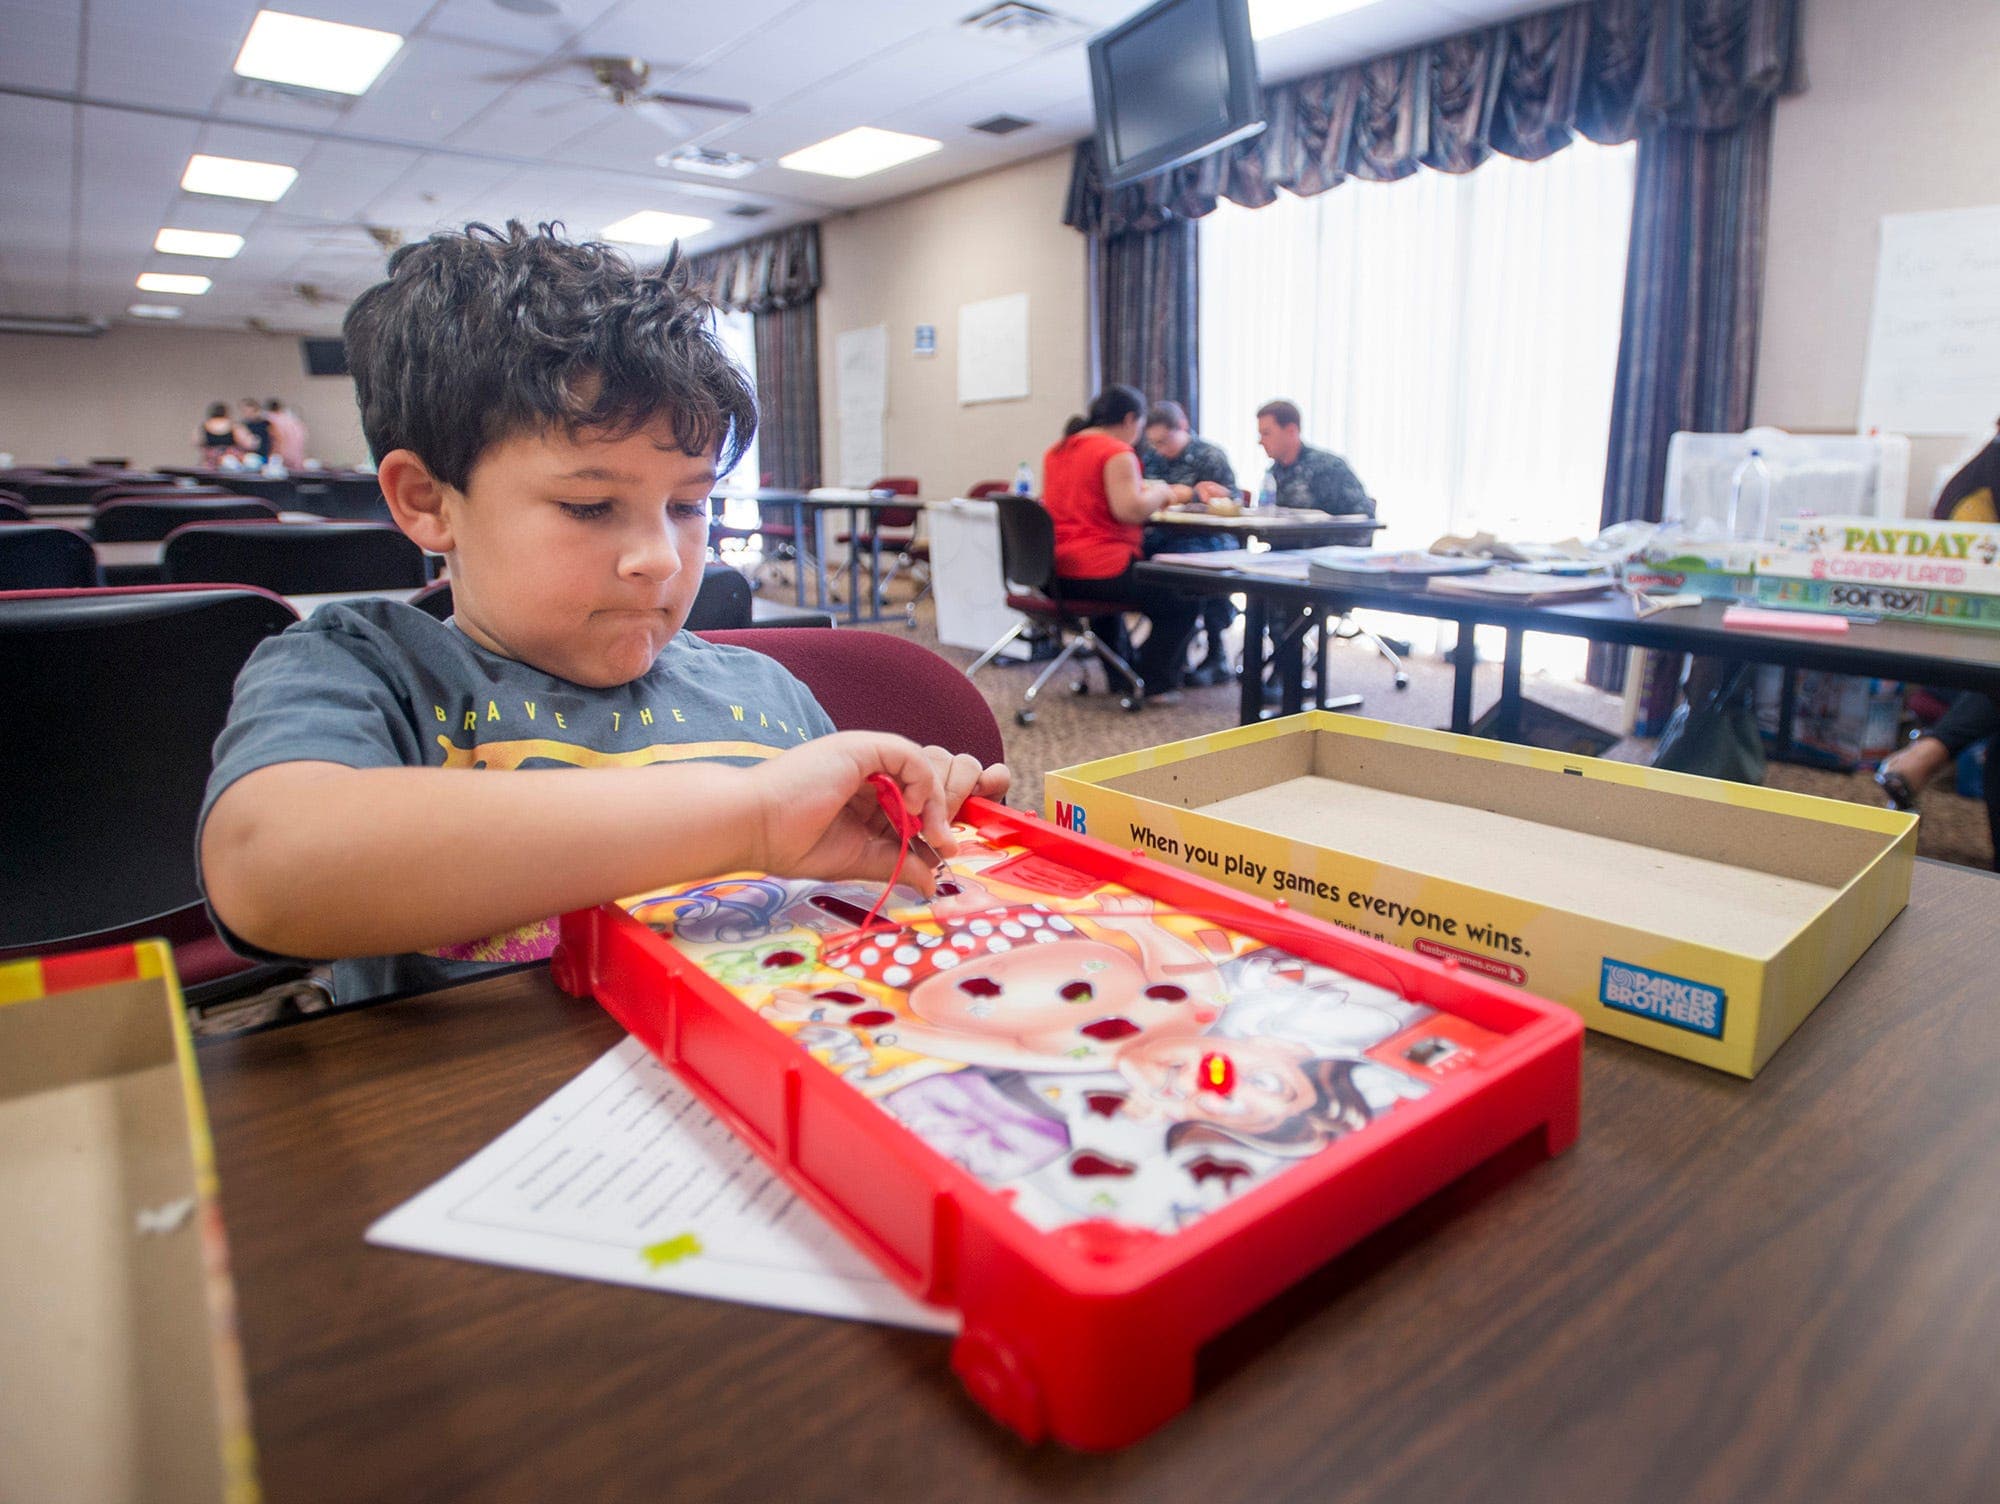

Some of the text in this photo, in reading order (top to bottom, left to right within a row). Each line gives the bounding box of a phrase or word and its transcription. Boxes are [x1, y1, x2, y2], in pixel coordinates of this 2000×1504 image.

[1843, 527, 1979, 559] PAYDAY
[1830, 558, 1966, 585] CANDY LAND
[434, 700, 808, 742] BRAVE THE WAVE
[1055, 800, 1087, 836] MB
[1130, 823, 1531, 957] When you play games everyone wins.
[1334, 919, 1356, 932] Visit
[1606, 985, 1716, 1029] BROTHERS
[1635, 973, 1718, 1011] PARKER
